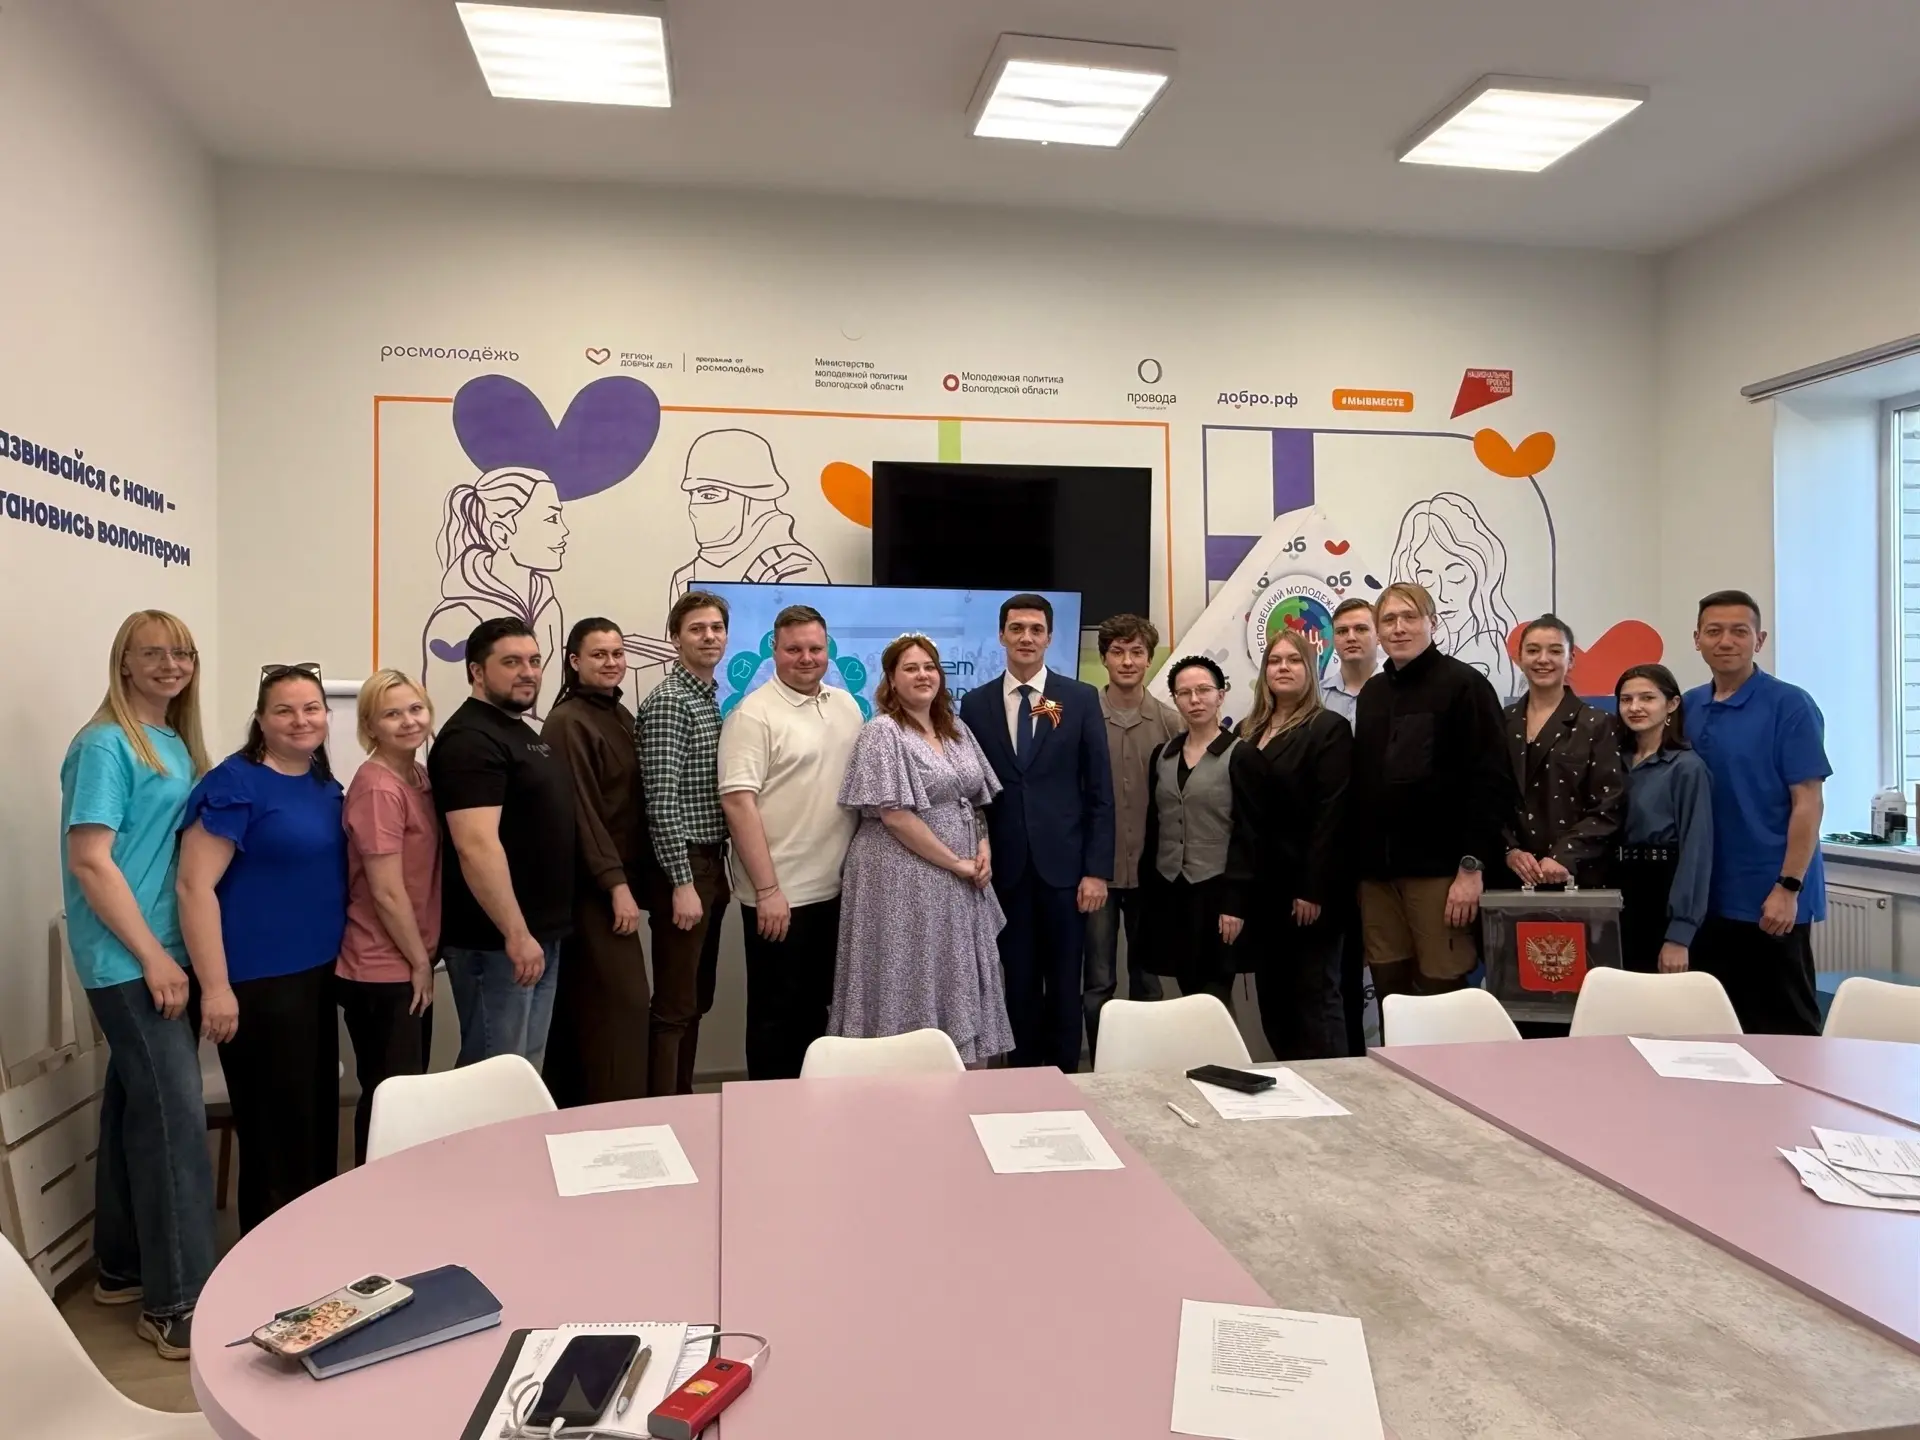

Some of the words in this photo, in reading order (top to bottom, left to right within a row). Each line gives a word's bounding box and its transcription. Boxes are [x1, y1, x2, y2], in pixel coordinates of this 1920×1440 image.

[380, 345, 520, 362] росмолодёжь
[620, 352, 653, 361] РЕГИОН
[620, 360, 654, 369] ДОБРЫХ
[656, 361, 673, 369] ДЕЛ
[815, 358, 875, 369] Министерство
[870, 372, 908, 381] политики
[1022, 374, 1064, 384] политика
[815, 379, 868, 390] Вологодской
[870, 381, 904, 391] области
[961, 383, 1020, 395] Вологодской
[1022, 385, 1059, 395] области
[1127, 393, 1177, 405] провода
[1217, 390, 1298, 408] добро.рф
[1341, 396, 1405, 407] #МЫВМЕСТЕ
[109, 474, 120, 497] с
[123, 479, 164, 514] нами
[97, 520, 191, 568] волонтером
[1325, 570, 1352, 588] об
[1256, 588, 1286, 654] РЕПОВЕЦКИЙ
